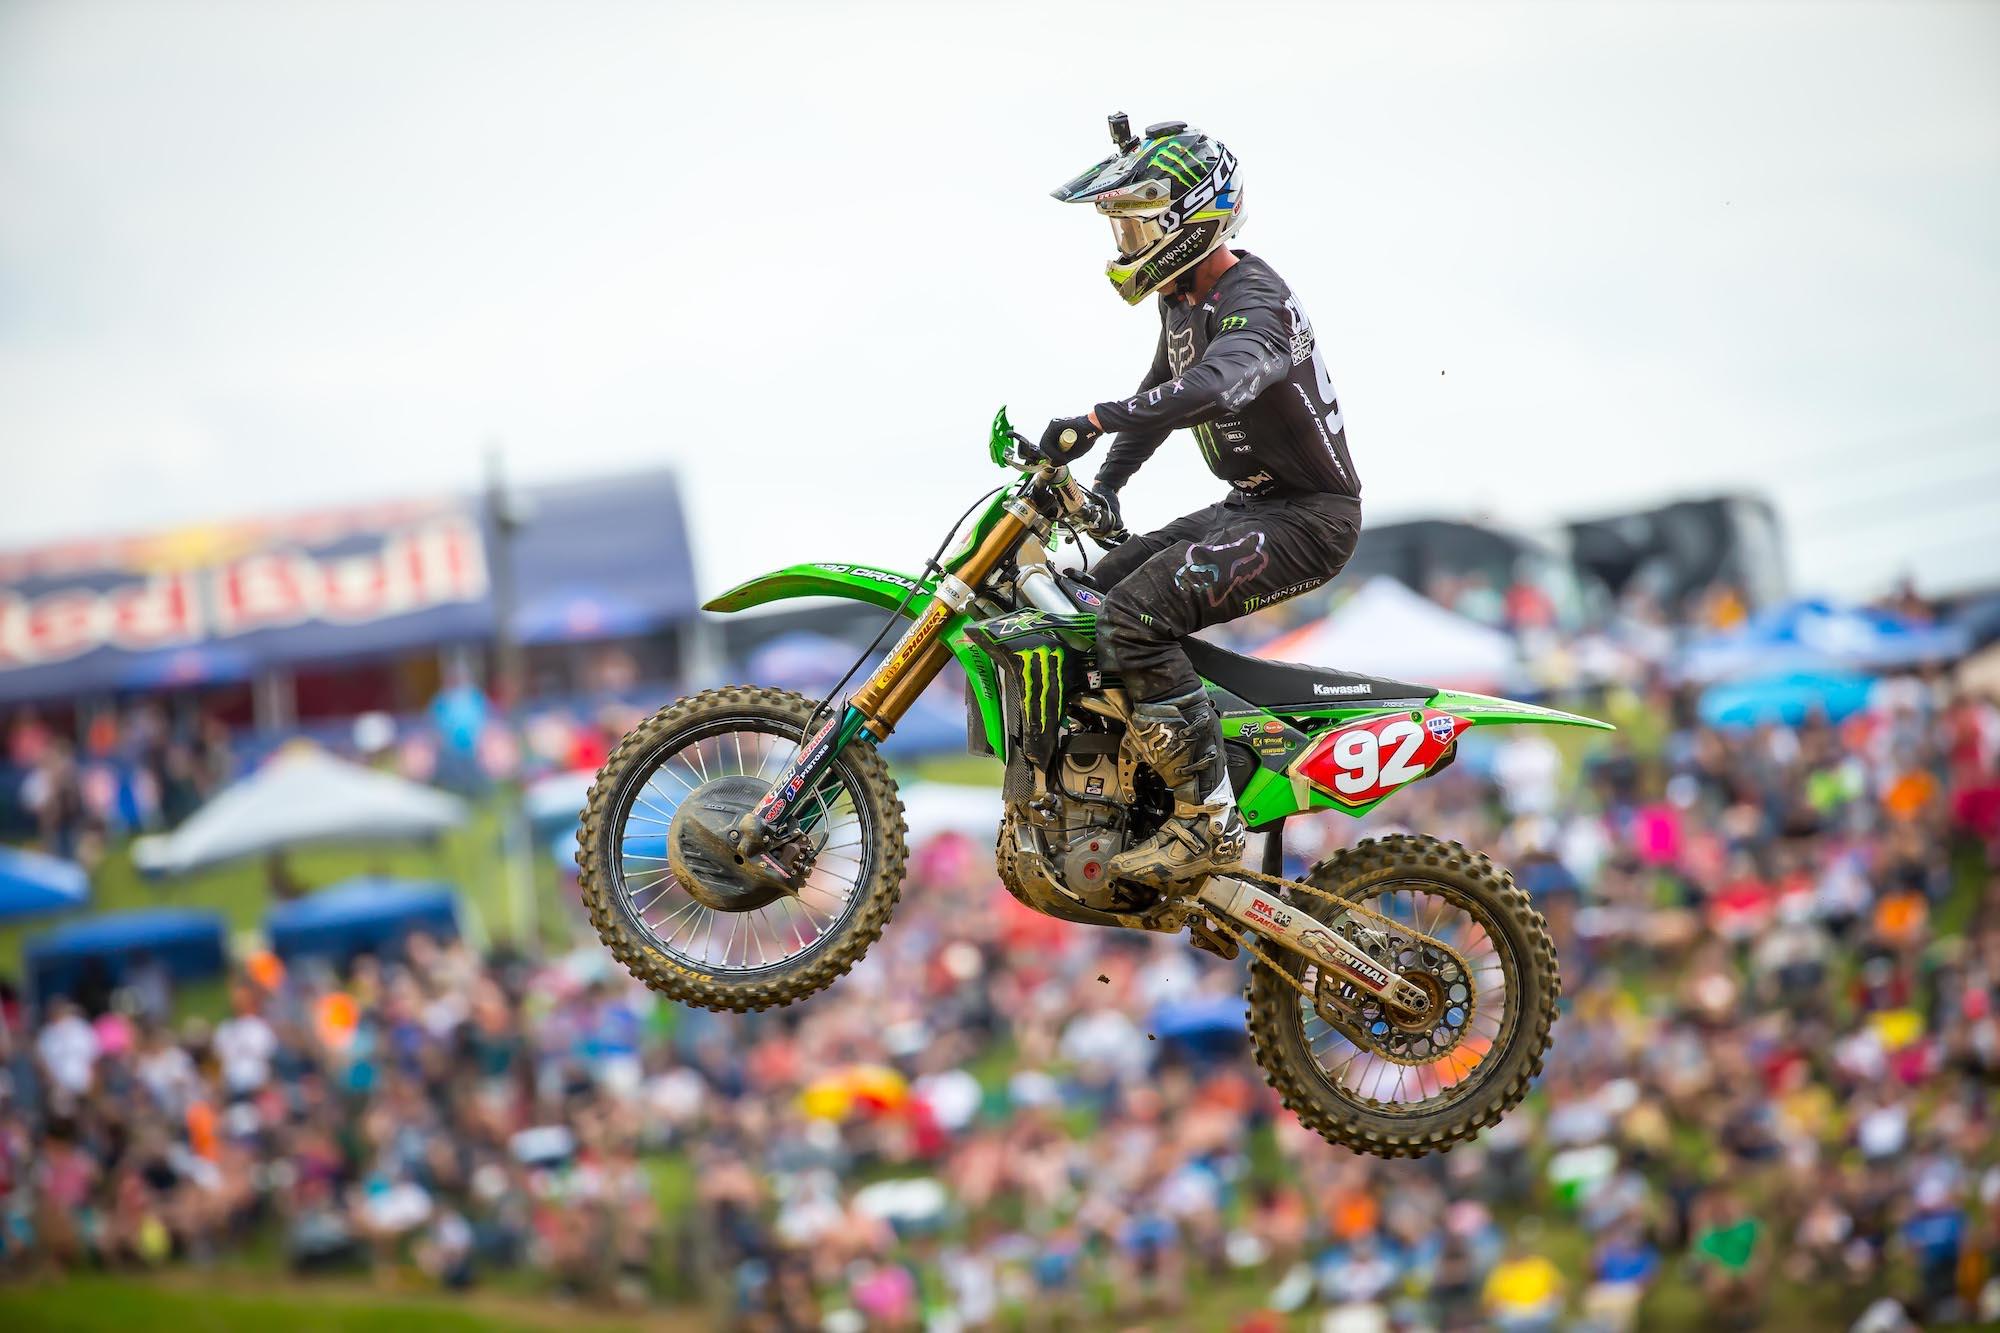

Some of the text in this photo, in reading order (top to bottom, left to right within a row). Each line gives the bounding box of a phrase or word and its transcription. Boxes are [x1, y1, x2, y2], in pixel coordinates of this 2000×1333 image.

[1158, 227, 1205, 266] MONSTER
[1293, 383, 1316, 414] PRO
[1260, 579, 1321, 605] MONSTER
[901, 610, 942, 661] SHOWA
[1313, 683, 1371, 695] Kawasaki
[798, 719, 836, 765] BRAKING
[1334, 719, 1425, 794] 92
[801, 743, 829, 779] PISTONS
[1244, 910, 1286, 933] BRAKING
[1252, 899, 1275, 915] RK
